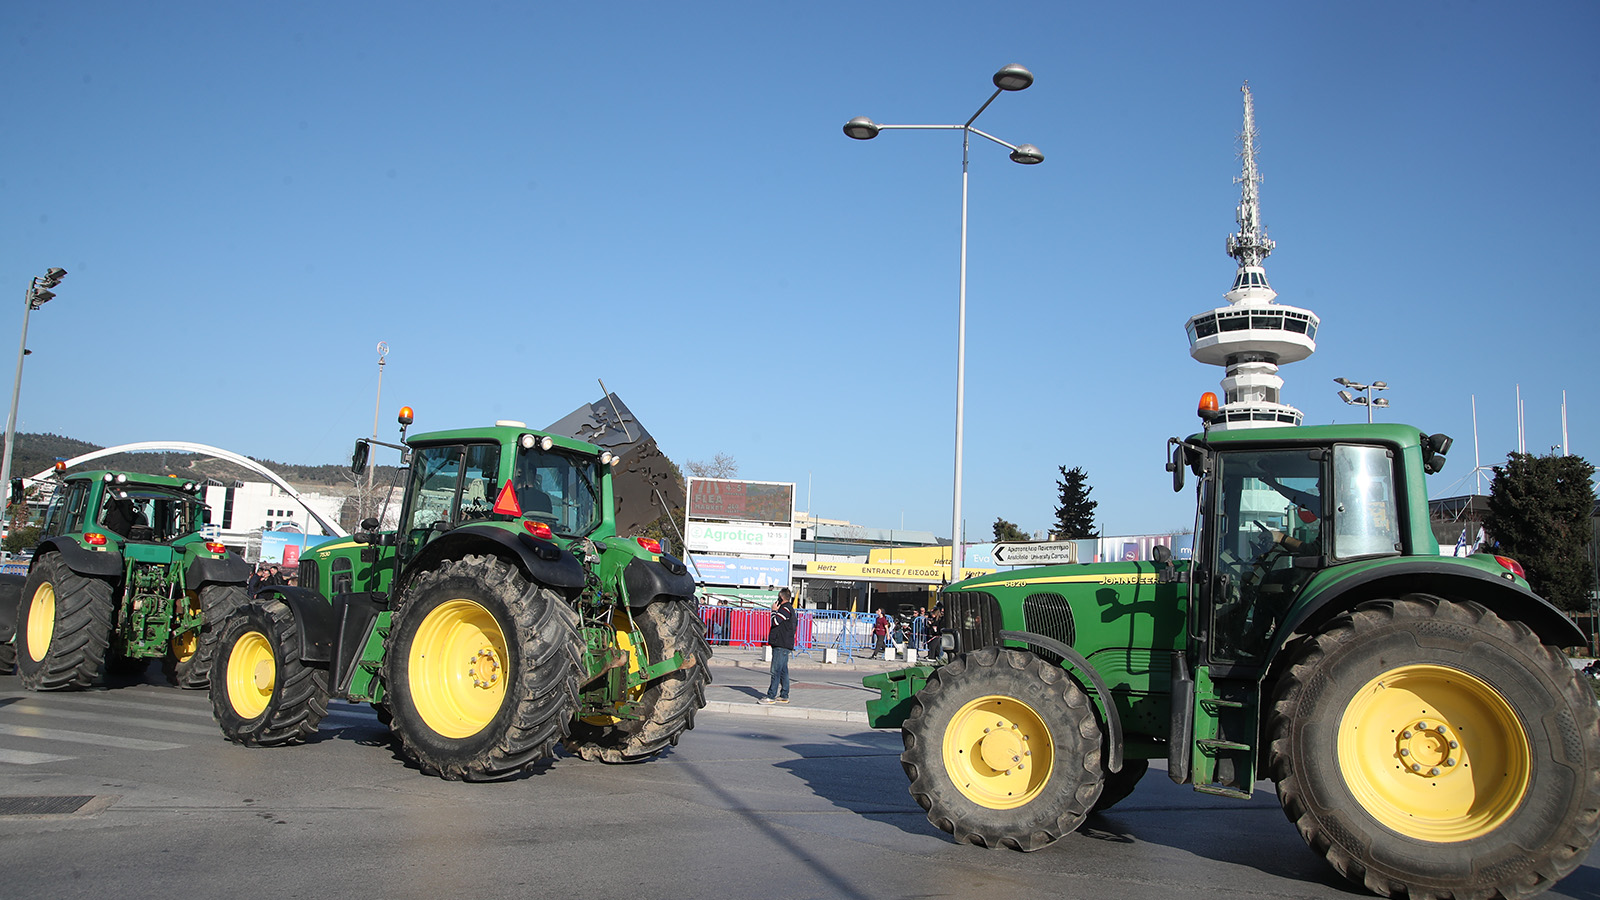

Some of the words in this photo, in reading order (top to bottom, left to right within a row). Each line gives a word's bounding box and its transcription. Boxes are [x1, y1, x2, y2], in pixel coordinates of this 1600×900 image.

[695, 494, 723, 504] FLEA
[703, 527, 763, 542] Agrotica
[861, 567, 901, 575] ENTRANCE
[907, 569, 939, 577] ΕΙΣΟΔΟΣ
[1004, 580, 1027, 588] 6820
[1099, 576, 1129, 585] JOHN
